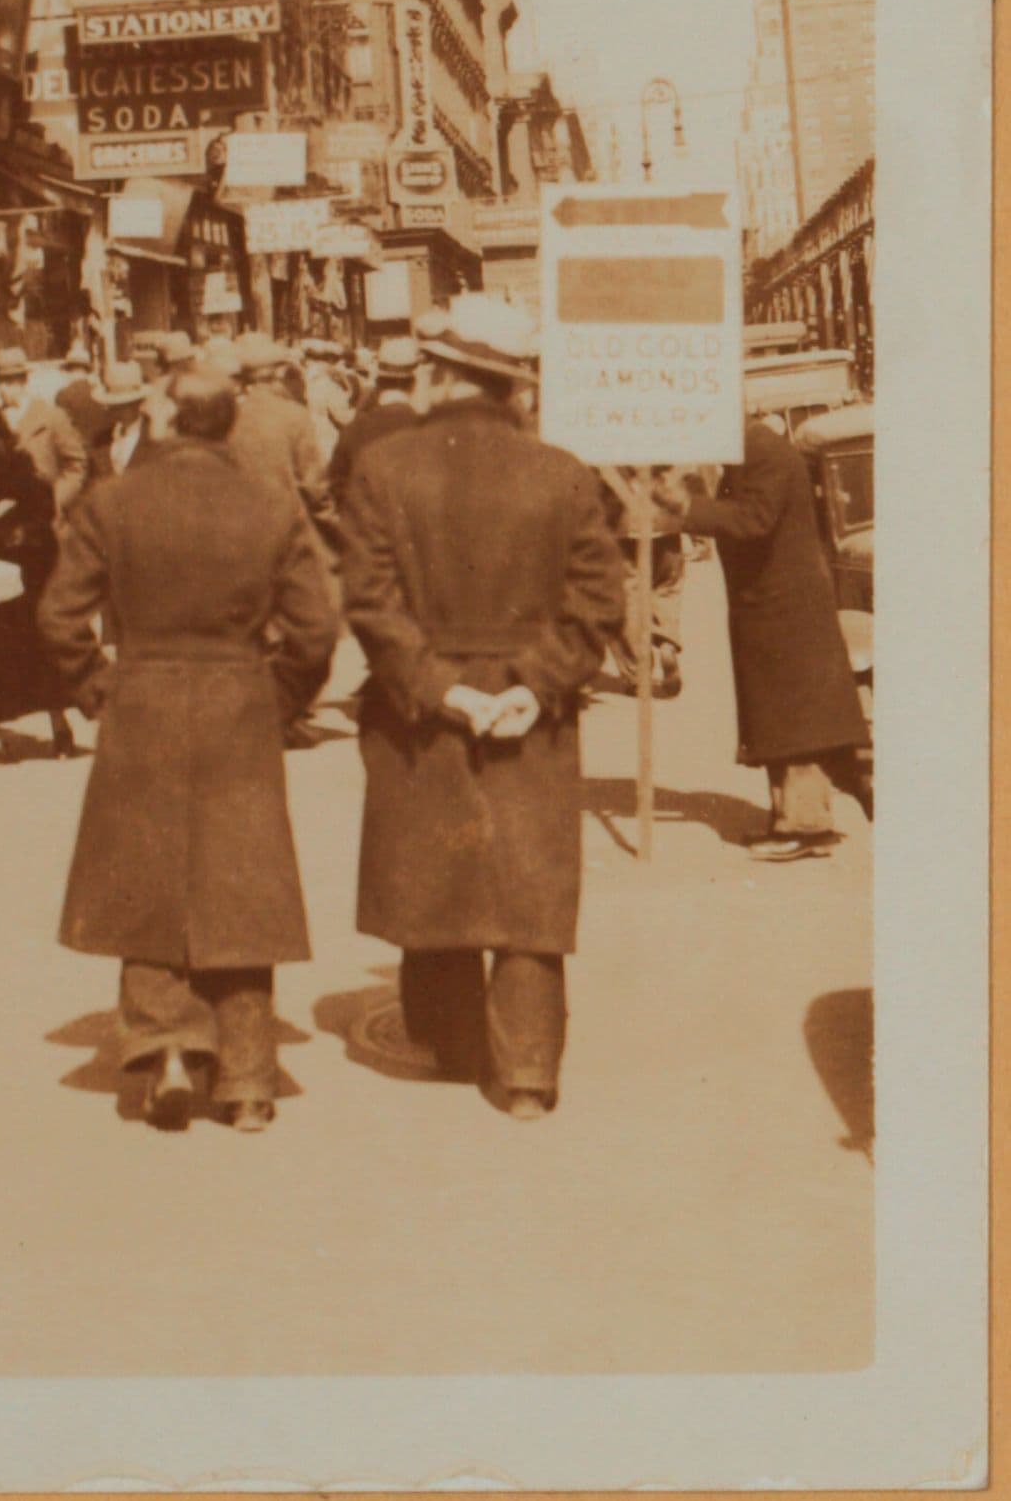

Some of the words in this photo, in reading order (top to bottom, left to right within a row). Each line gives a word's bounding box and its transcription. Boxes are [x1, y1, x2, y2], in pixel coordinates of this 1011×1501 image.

[85, 6, 273, 37] STATIONERY
[23, 58, 253, 101] DELICATESSEN
[86, 103, 189, 132] SODA
